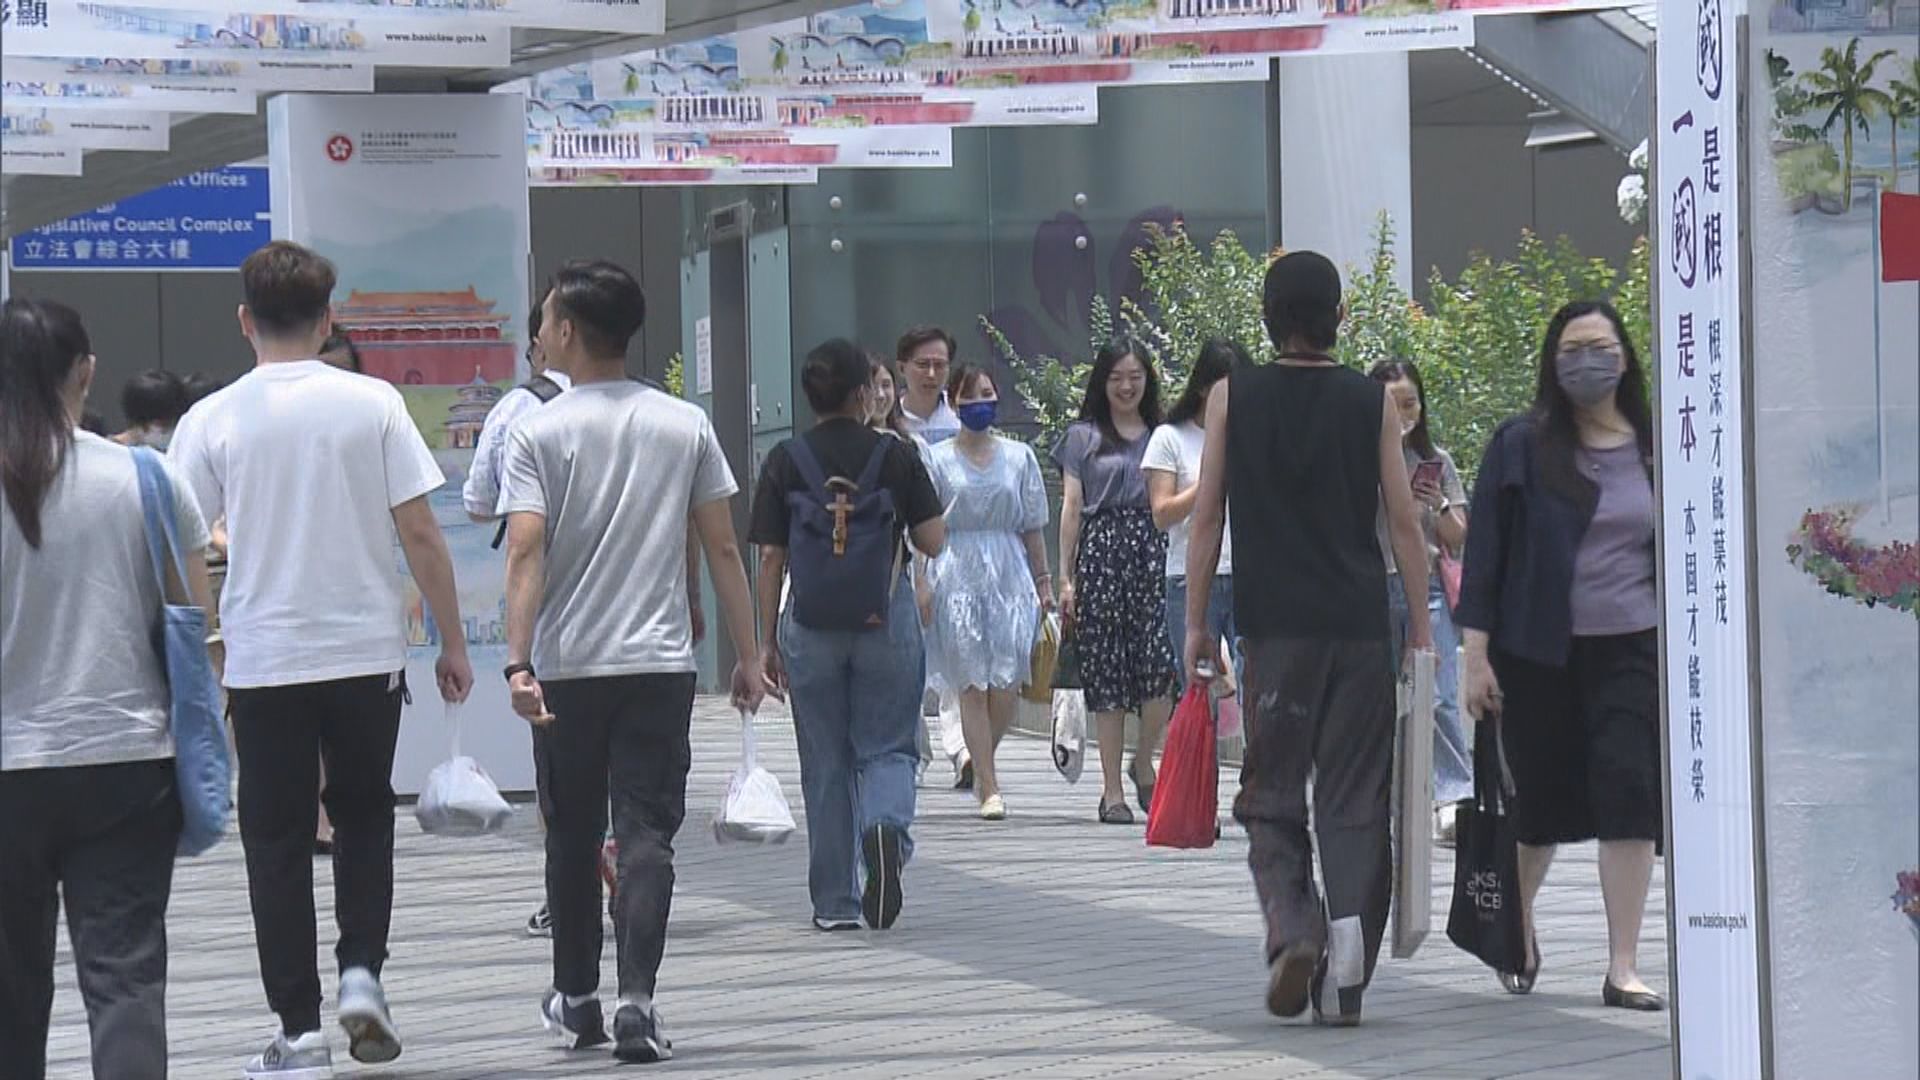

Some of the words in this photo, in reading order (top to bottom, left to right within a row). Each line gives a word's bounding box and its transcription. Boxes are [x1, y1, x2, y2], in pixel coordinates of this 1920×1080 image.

[385, 32, 487, 44] www.basiclaw.gov.hk
[33, 218, 109, 235] gislative
[114, 217, 176, 232] Council
[181, 217, 253, 234] Complex
[24, 239, 190, 259] 立法會綜合大樓
[1688, 912, 1748, 932] www.basiclaw.gov.hk
